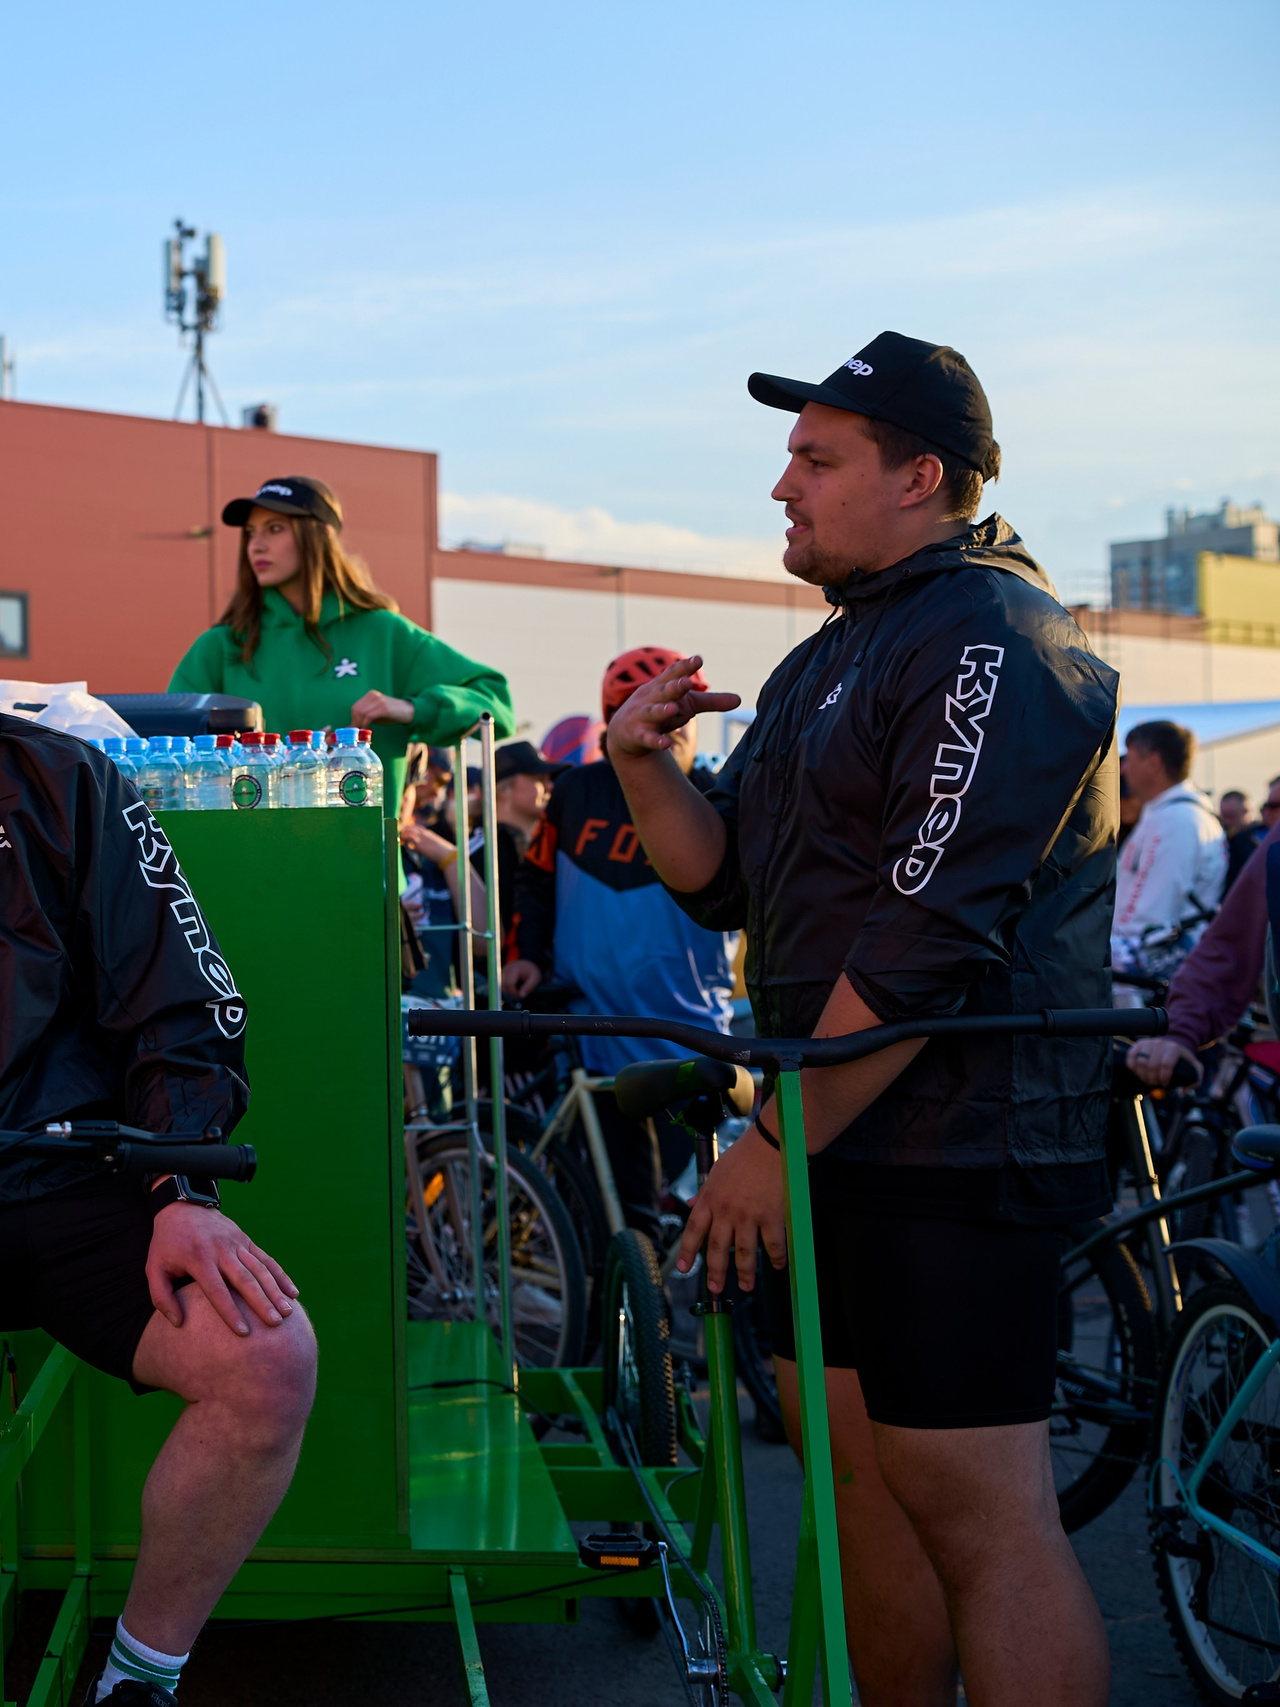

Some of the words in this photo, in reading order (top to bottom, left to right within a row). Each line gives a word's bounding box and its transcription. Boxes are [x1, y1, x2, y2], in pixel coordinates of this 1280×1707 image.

[575, 818, 653, 866] FO
[892, 643, 1005, 896] купер
[122, 800, 248, 1040] купер
